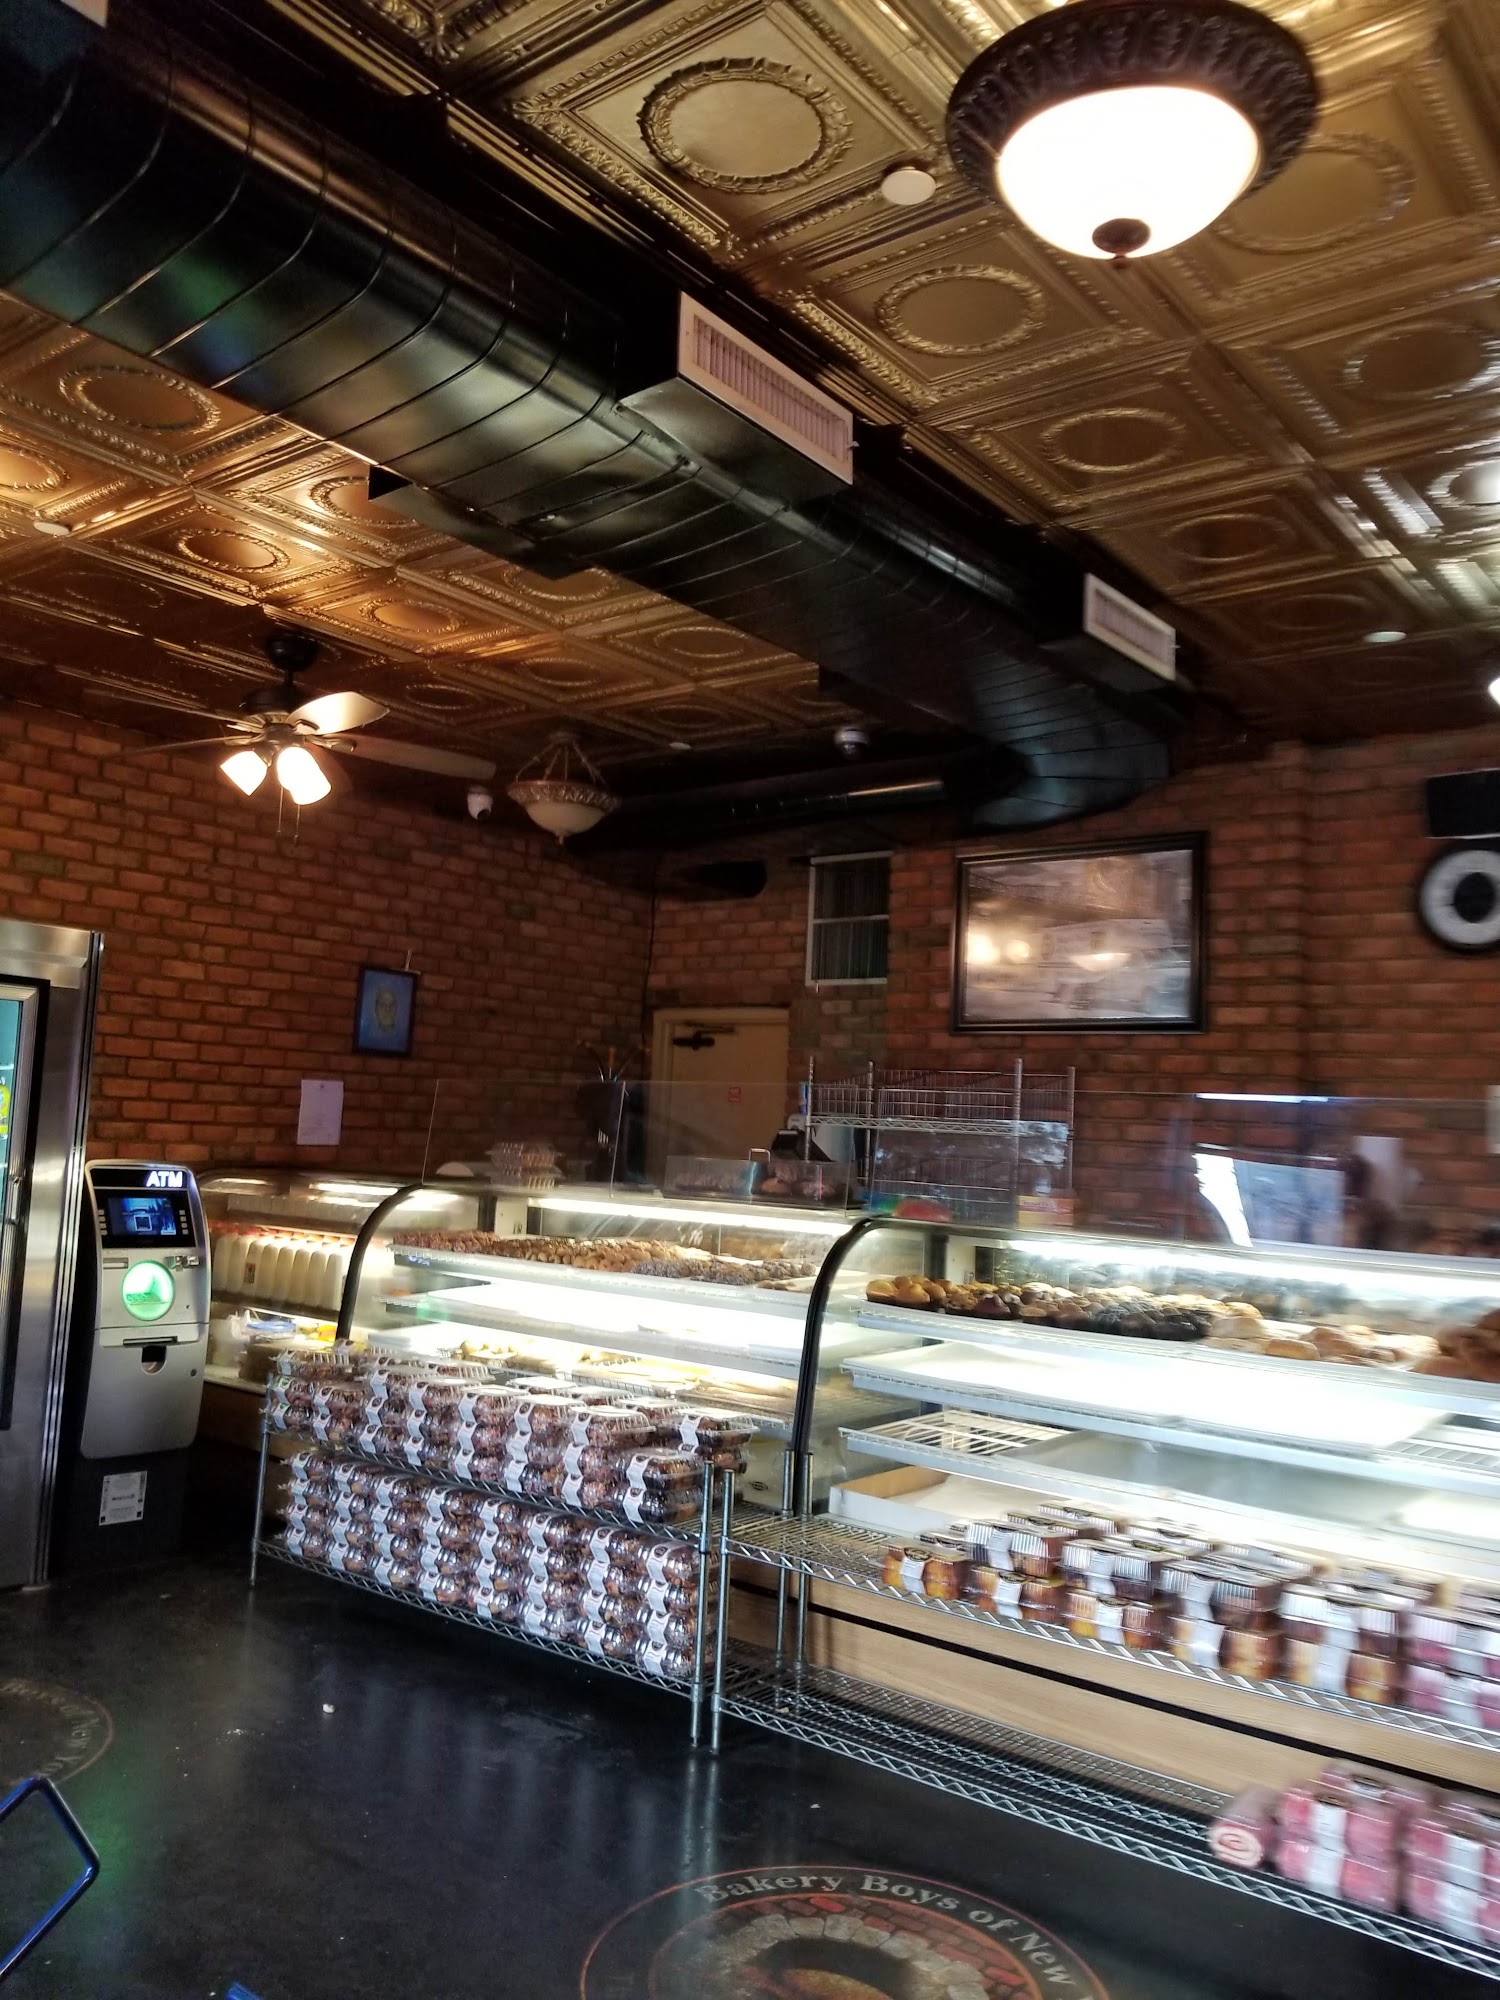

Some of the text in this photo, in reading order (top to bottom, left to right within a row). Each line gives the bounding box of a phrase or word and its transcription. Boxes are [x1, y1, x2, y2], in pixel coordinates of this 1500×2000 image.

[146, 1170, 183, 1188] ATM
[694, 1874, 1077, 1985] Bakery Boys of New
